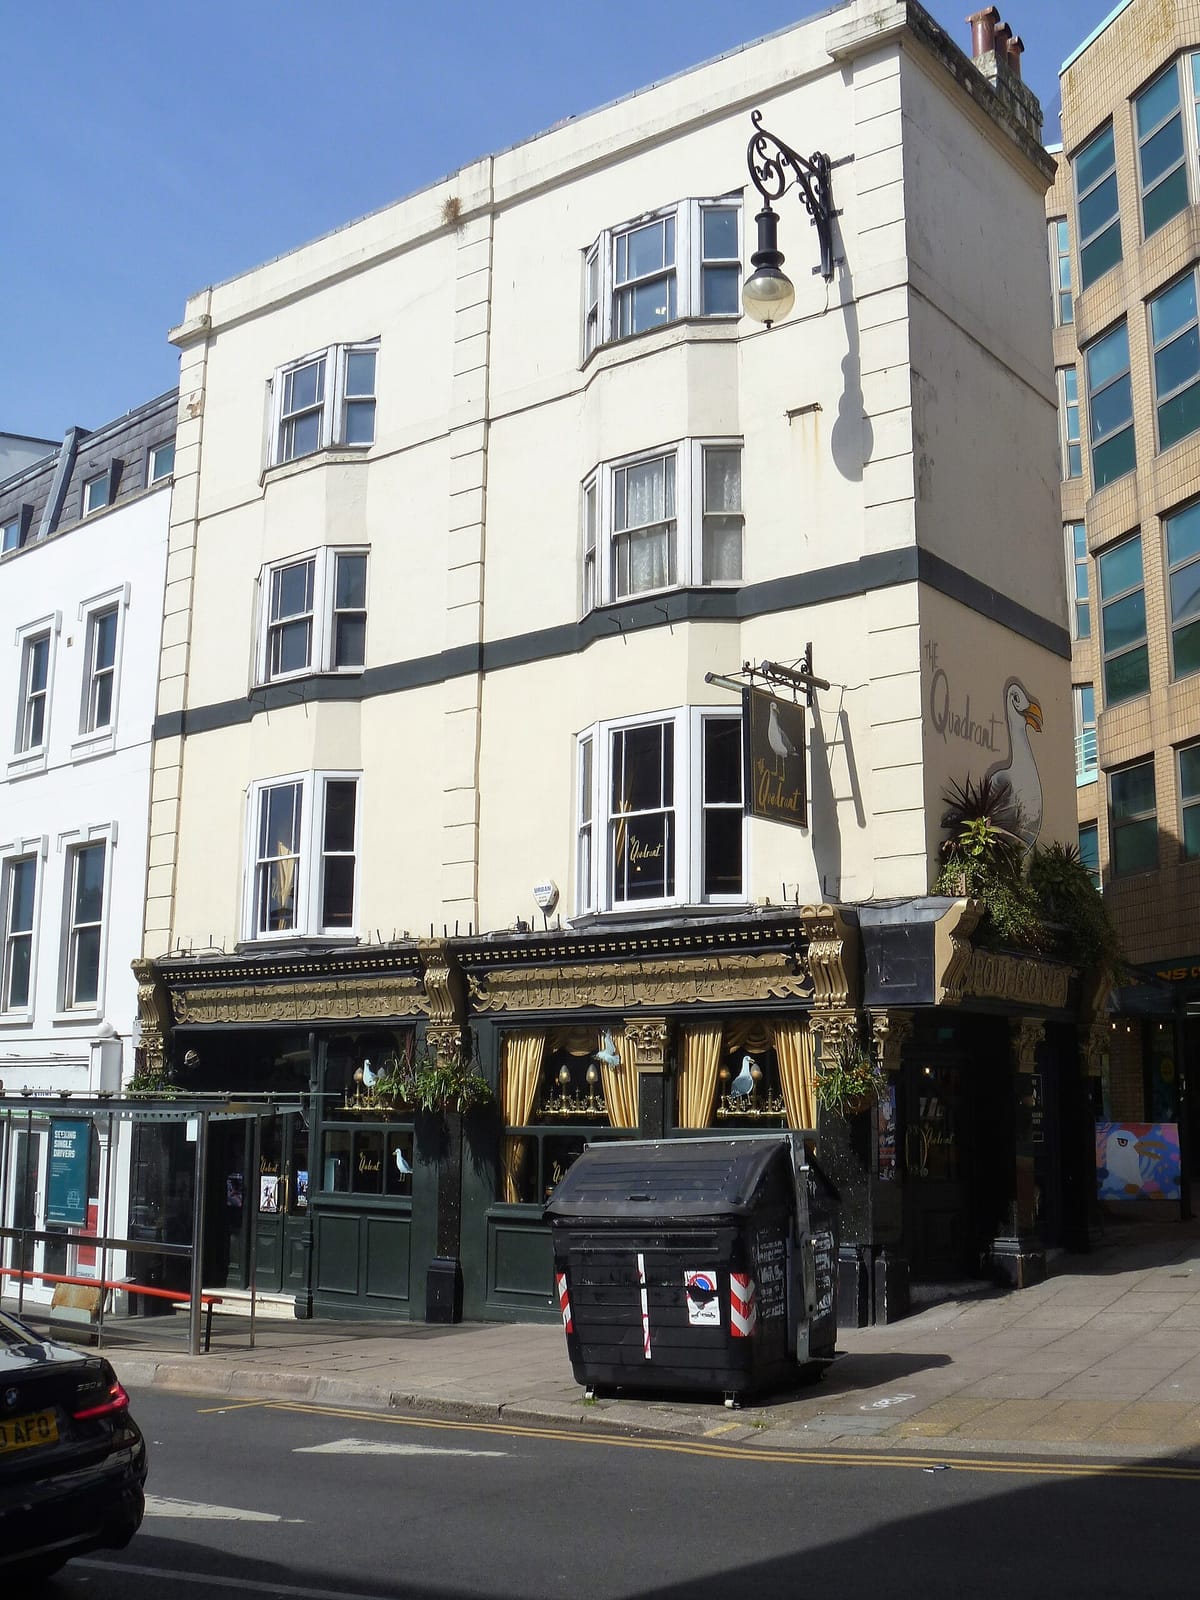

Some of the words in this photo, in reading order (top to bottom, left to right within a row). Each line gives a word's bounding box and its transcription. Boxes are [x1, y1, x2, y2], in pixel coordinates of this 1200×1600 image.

[930, 668, 1004, 753] Quadrant
[759, 769, 802, 814] Quadrant
[53, 1149, 75, 1158] DRIVERS
[54, 1140, 72, 1148] SINGLE
[14, 1417, 51, 1444] AFO
